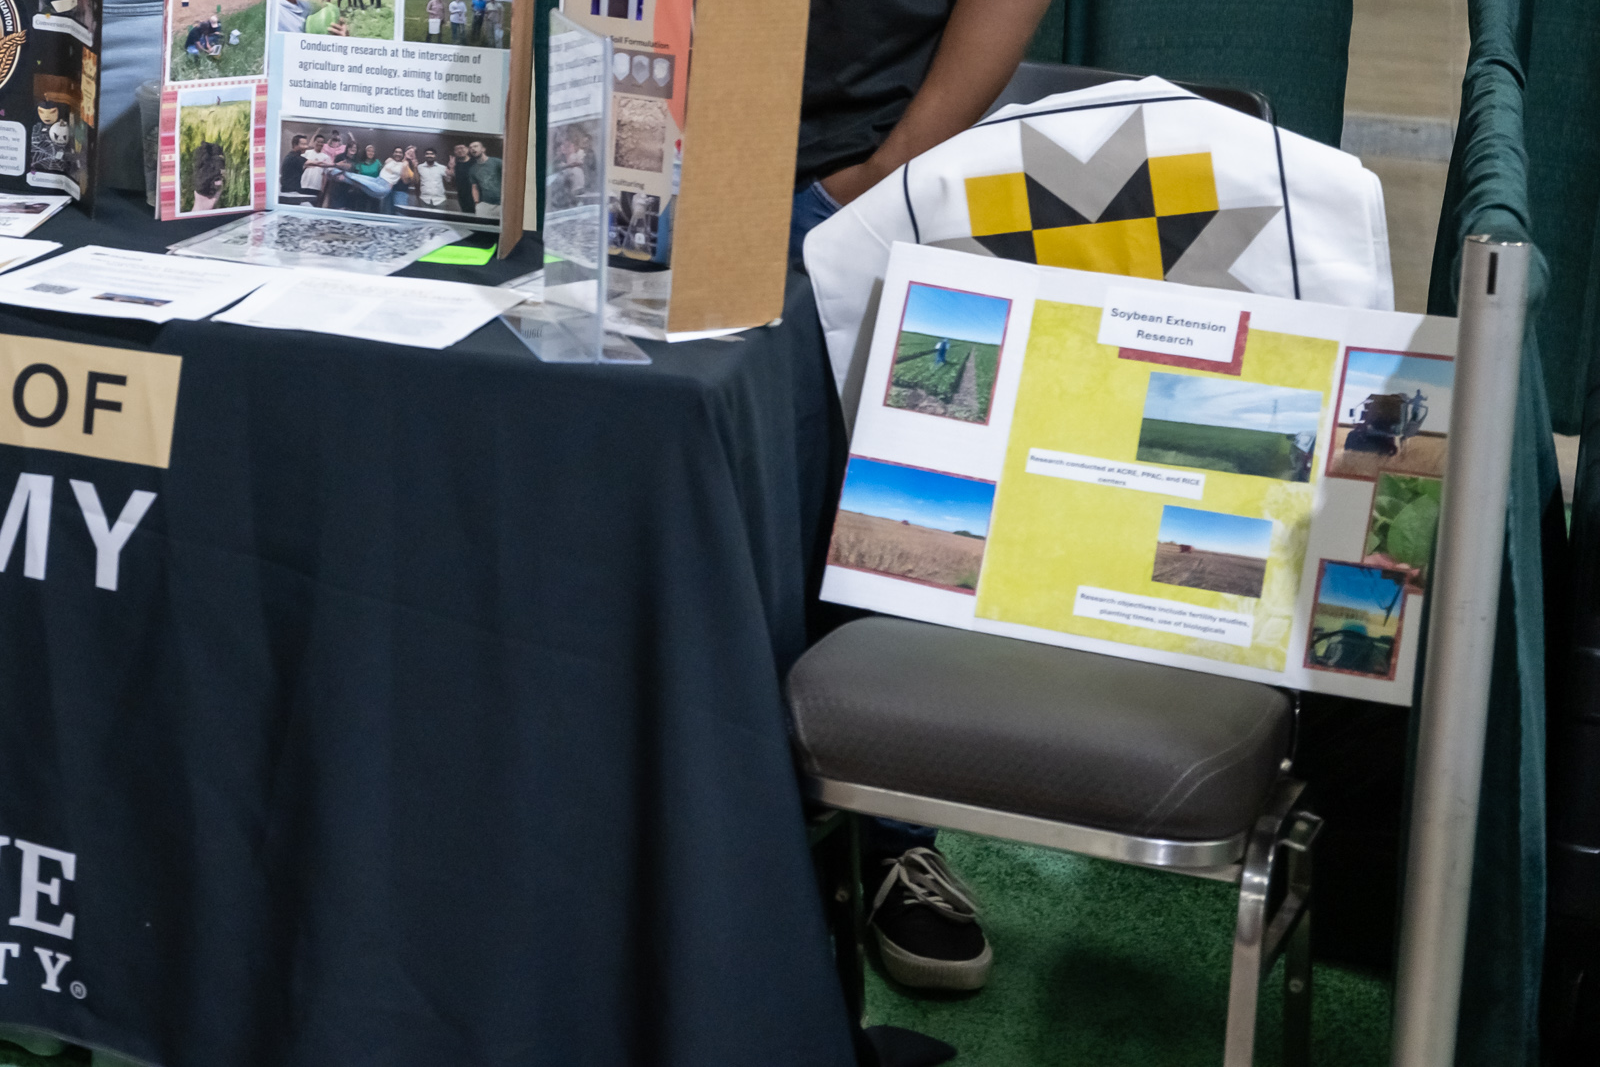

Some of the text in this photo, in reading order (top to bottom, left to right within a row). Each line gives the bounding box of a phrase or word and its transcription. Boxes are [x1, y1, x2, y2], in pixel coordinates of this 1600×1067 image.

[300, 39, 481, 64] Conducting research at the intersection of
[624, 37, 669, 50] Formulation
[298, 60, 482, 84] agriculture and ecology, aiming to promote
[289, 78, 490, 104] sustainable farming practices that benefit both
[299, 97, 478, 123] human communities and the environment.
[1111, 307, 1226, 332] Soybean Extension
[1136, 329, 1194, 346] Research
[12, 362, 128, 436] OF
